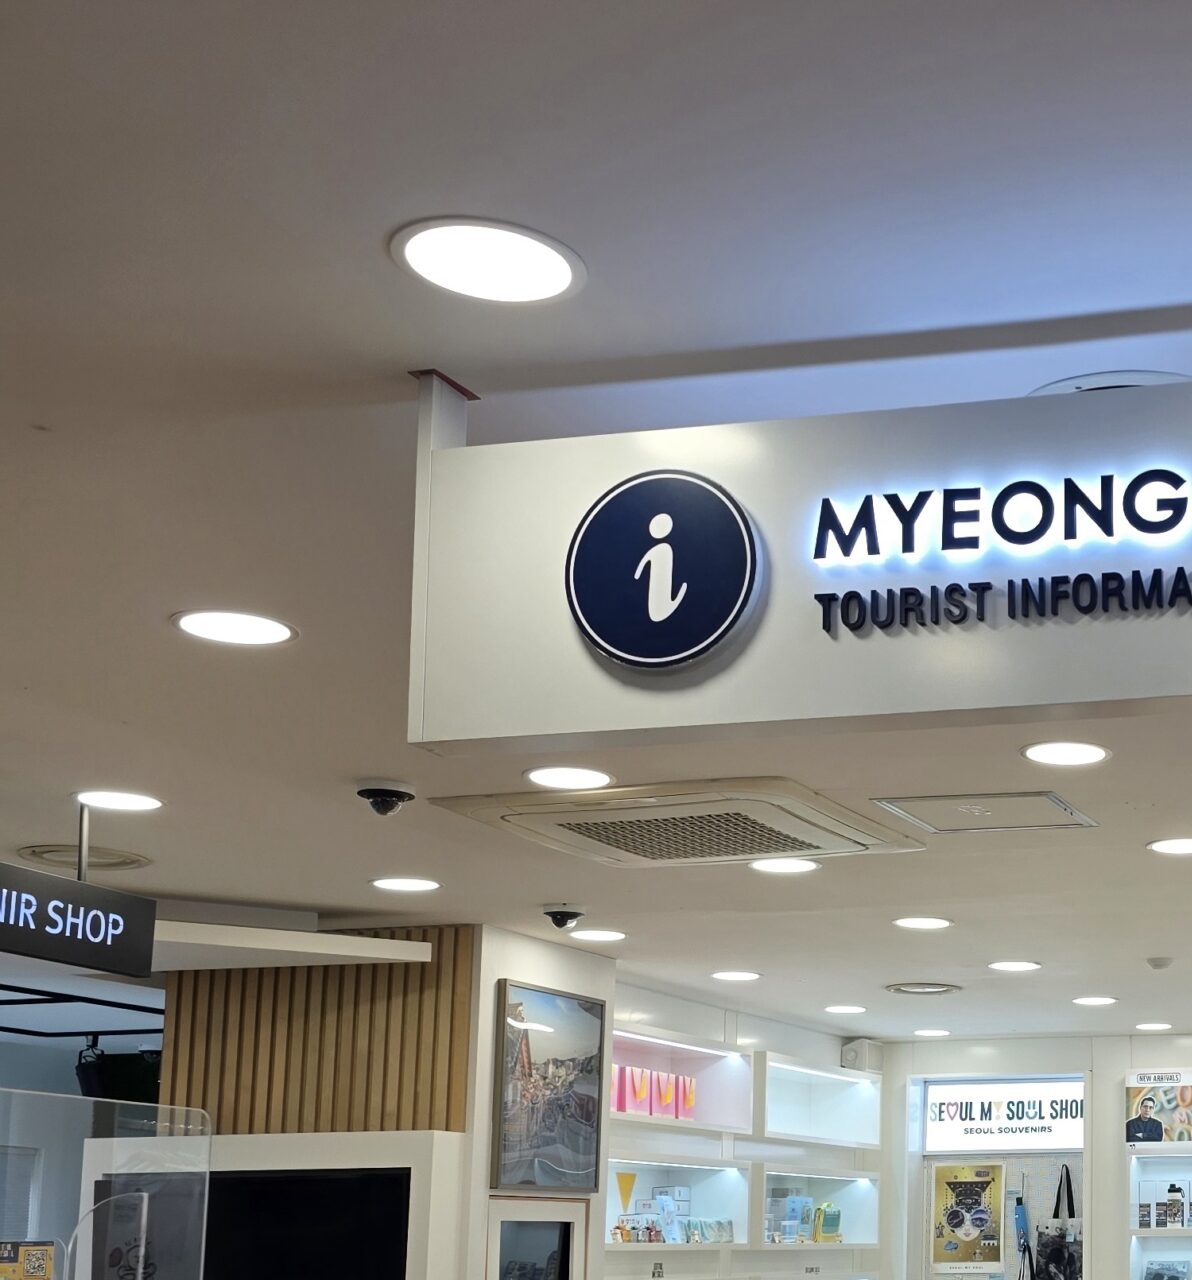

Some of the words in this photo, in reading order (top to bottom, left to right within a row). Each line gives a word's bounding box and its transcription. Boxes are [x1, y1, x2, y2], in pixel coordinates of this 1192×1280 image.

[813, 469, 1188, 559] MYEONG
[815, 581, 992, 632] TOURIST
[45, 900, 124, 945] SHOP
[1153, 1074, 1180, 1082] ARRIVALS
[1006, 1100, 1045, 1121] SOUL
[963, 1127, 995, 1135] SEOUL
[997, 1126, 1053, 1134] SOUVENIRS
